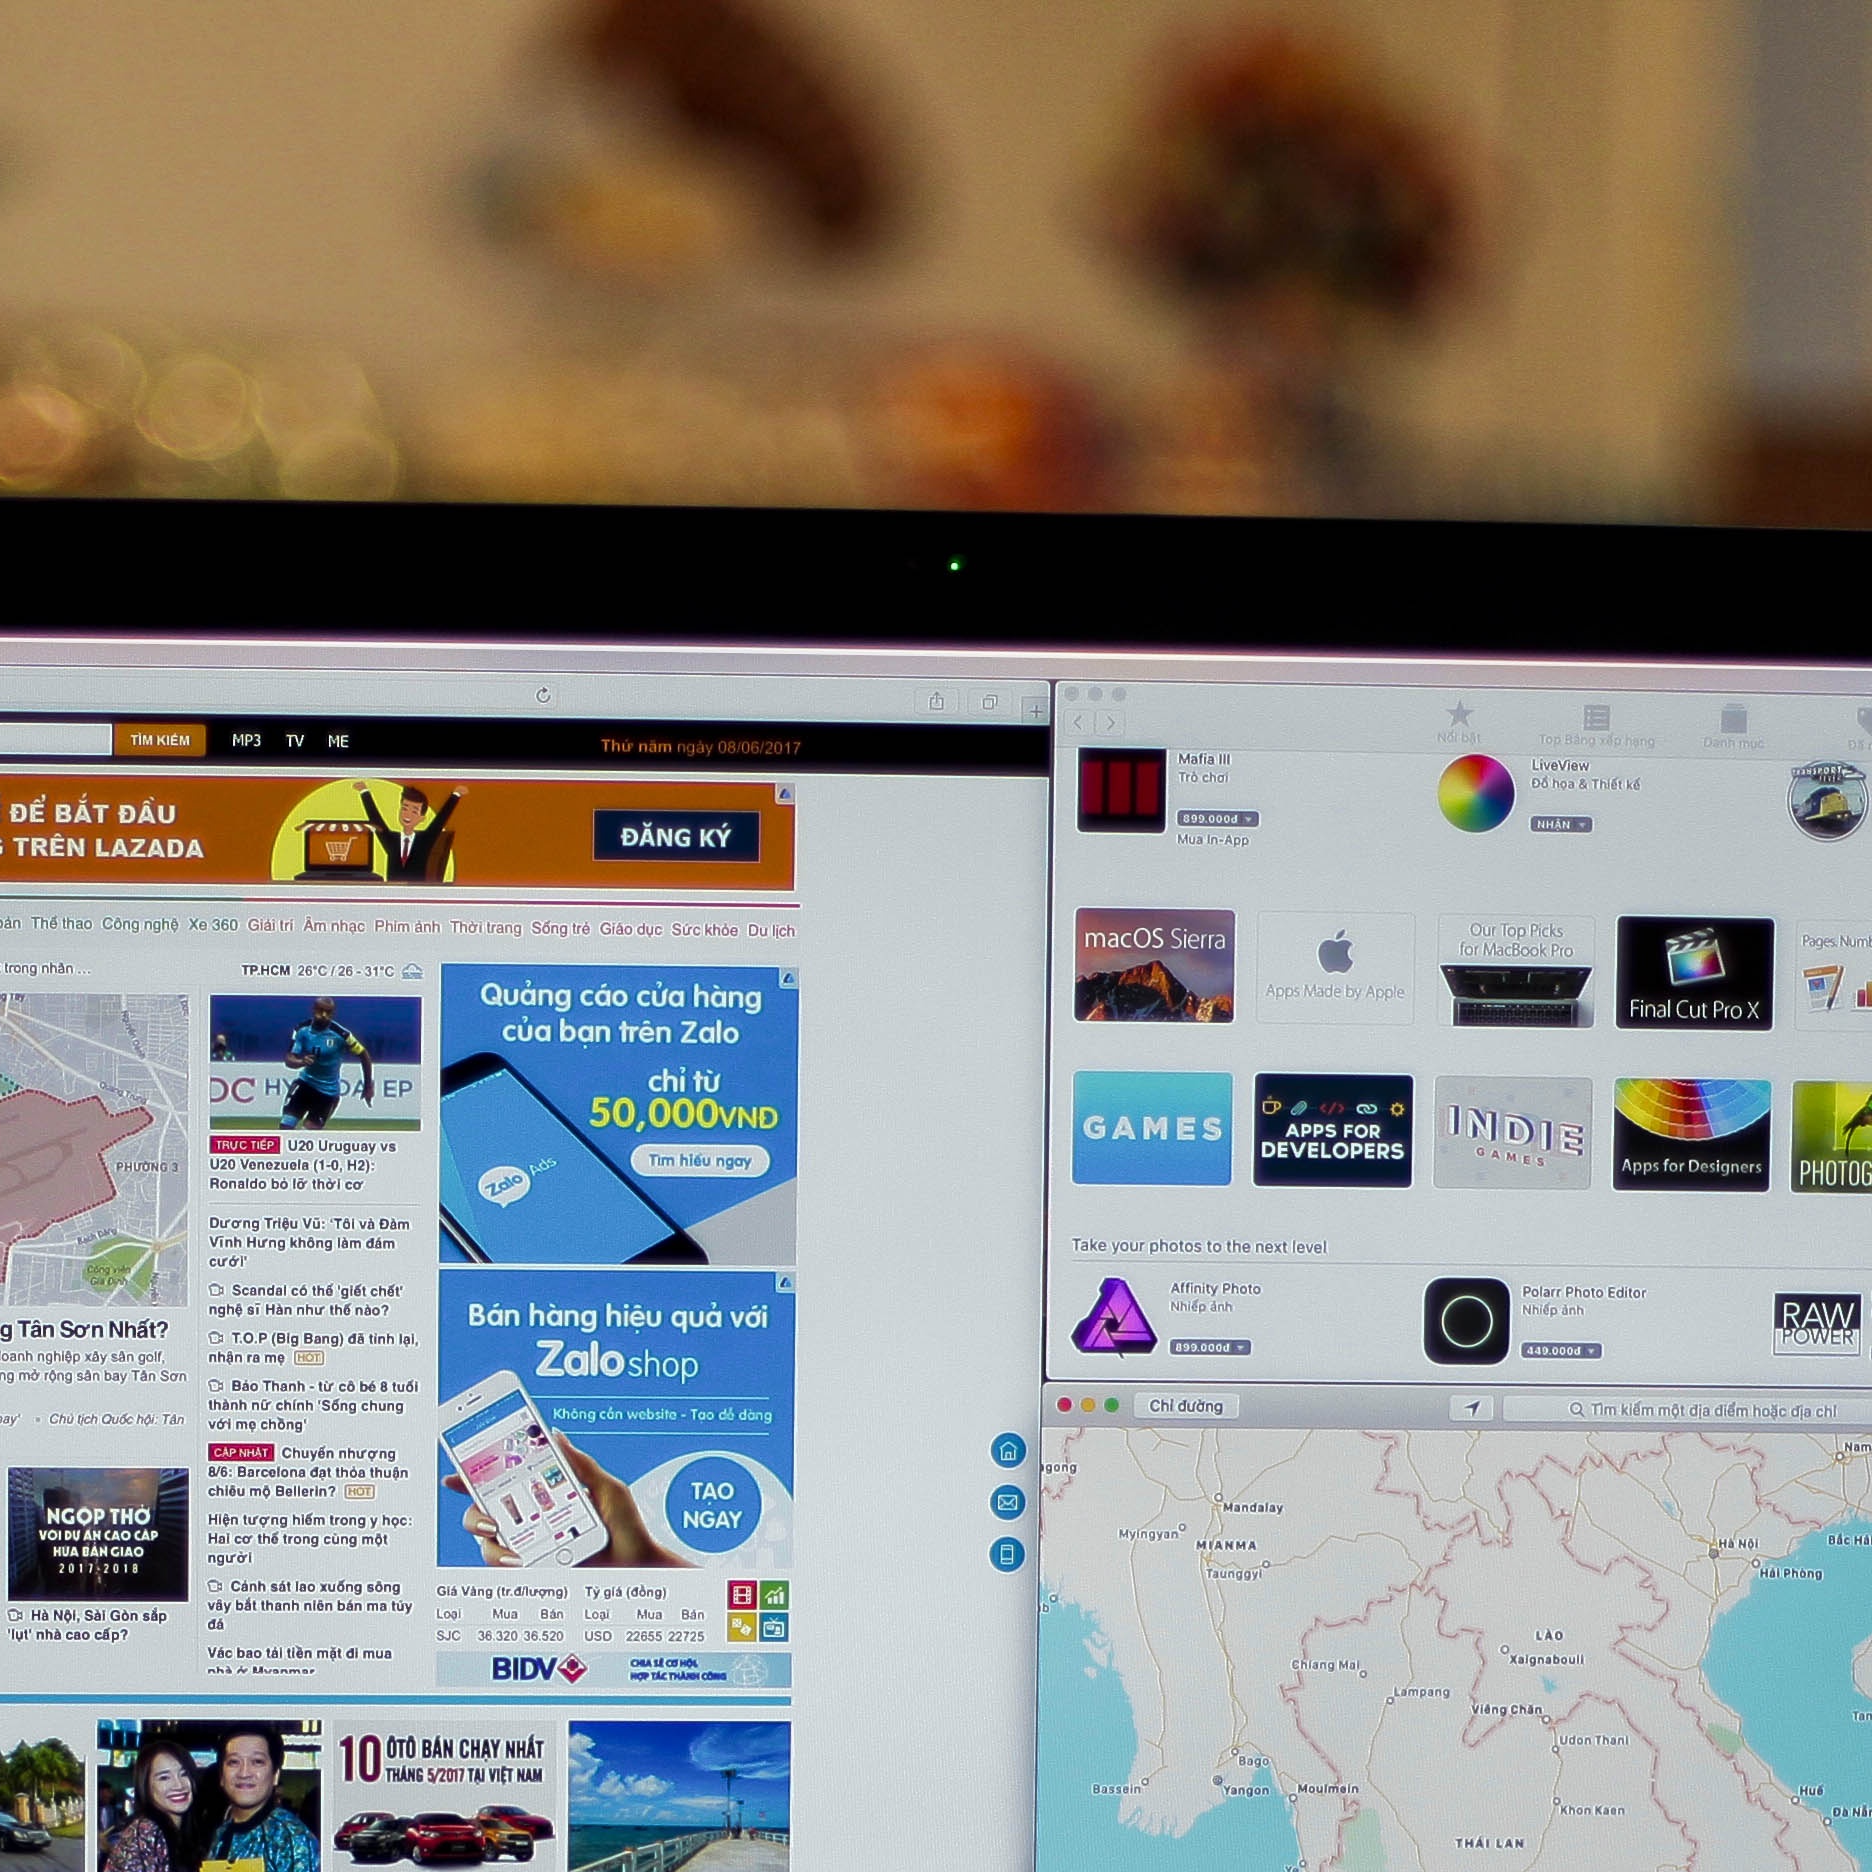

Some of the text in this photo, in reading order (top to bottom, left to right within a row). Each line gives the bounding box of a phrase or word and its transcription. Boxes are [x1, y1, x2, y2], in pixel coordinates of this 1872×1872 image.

[233, 733, 349, 748] MP3 TV ME
[718, 741, 800, 755] 08/06/2017
[1179, 753, 1230, 765] Mafia III
[10, 794, 45, 822] ĐỂ
[55, 793, 109, 824] BẮT
[118, 797, 175, 824] ĐẦU
[621, 821, 731, 848] ĐĂNG KÝ
[13, 833, 85, 856] TRÊN
[96, 838, 204, 858] LAZADA
[1085, 927, 1225, 949] macOS Sierra
[1470, 923, 1563, 940] Our Top Picks
[1461, 938, 1573, 957] for MacBook Pro
[481, 979, 761, 1014] Quảng cáo cửa hàng
[1631, 999, 1759, 1020] Final Cut Pro X
[503, 1016, 739, 1049] của bạn trên Zalo
[649, 1066, 720, 1093] chỉ từ
[1083, 1115, 1221, 1141] GAMES
[1286, 1123, 1380, 1139] APPS FOR
[1448, 1104, 1584, 1157] INDIE
[1262, 1142, 1404, 1159] DEVELOPERS
[1477, 1147, 1544, 1167] GAMES
[485, 1157, 558, 1197] Zalo Ads
[1622, 1158, 1762, 1177] Apps for Designers
[1073, 1238, 1326, 1255] Take your photos to the next level
[1171, 1282, 1261, 1297] Affinity Photo
[469, 1302, 767, 1334] Bán hàng hiệu quả với
[1783, 1302, 1854, 1328] RAW
[18, 1320, 54, 1338] Tân
[61, 1321, 103, 1338] Sơn
[109, 1319, 168, 1338] Nhất?
[1782, 1327, 1854, 1345] POWER
[691, 1482, 734, 1506] TẠO
[1221, 1501, 1283, 1516] Mandalay
[684, 1510, 742, 1529] NGAY
[1197, 1540, 1256, 1552] MIANMA
[585, 1630, 704, 1642] USD 22655 22725
[493, 1657, 556, 1680] BIDV
[340, 1734, 381, 1782] 10
[387, 1736, 415, 1758] ÔTÔ
[422, 1735, 453, 1758] BÁN
[460, 1739, 500, 1761] CHẠY
[386, 1765, 423, 1782] THÁNG
[428, 1768, 464, 1784] 5/2017
[468, 1768, 485, 1785] TẠI
[517, 1768, 542, 1782] NAM
[1456, 1836, 1524, 1849] THÁI LAN
